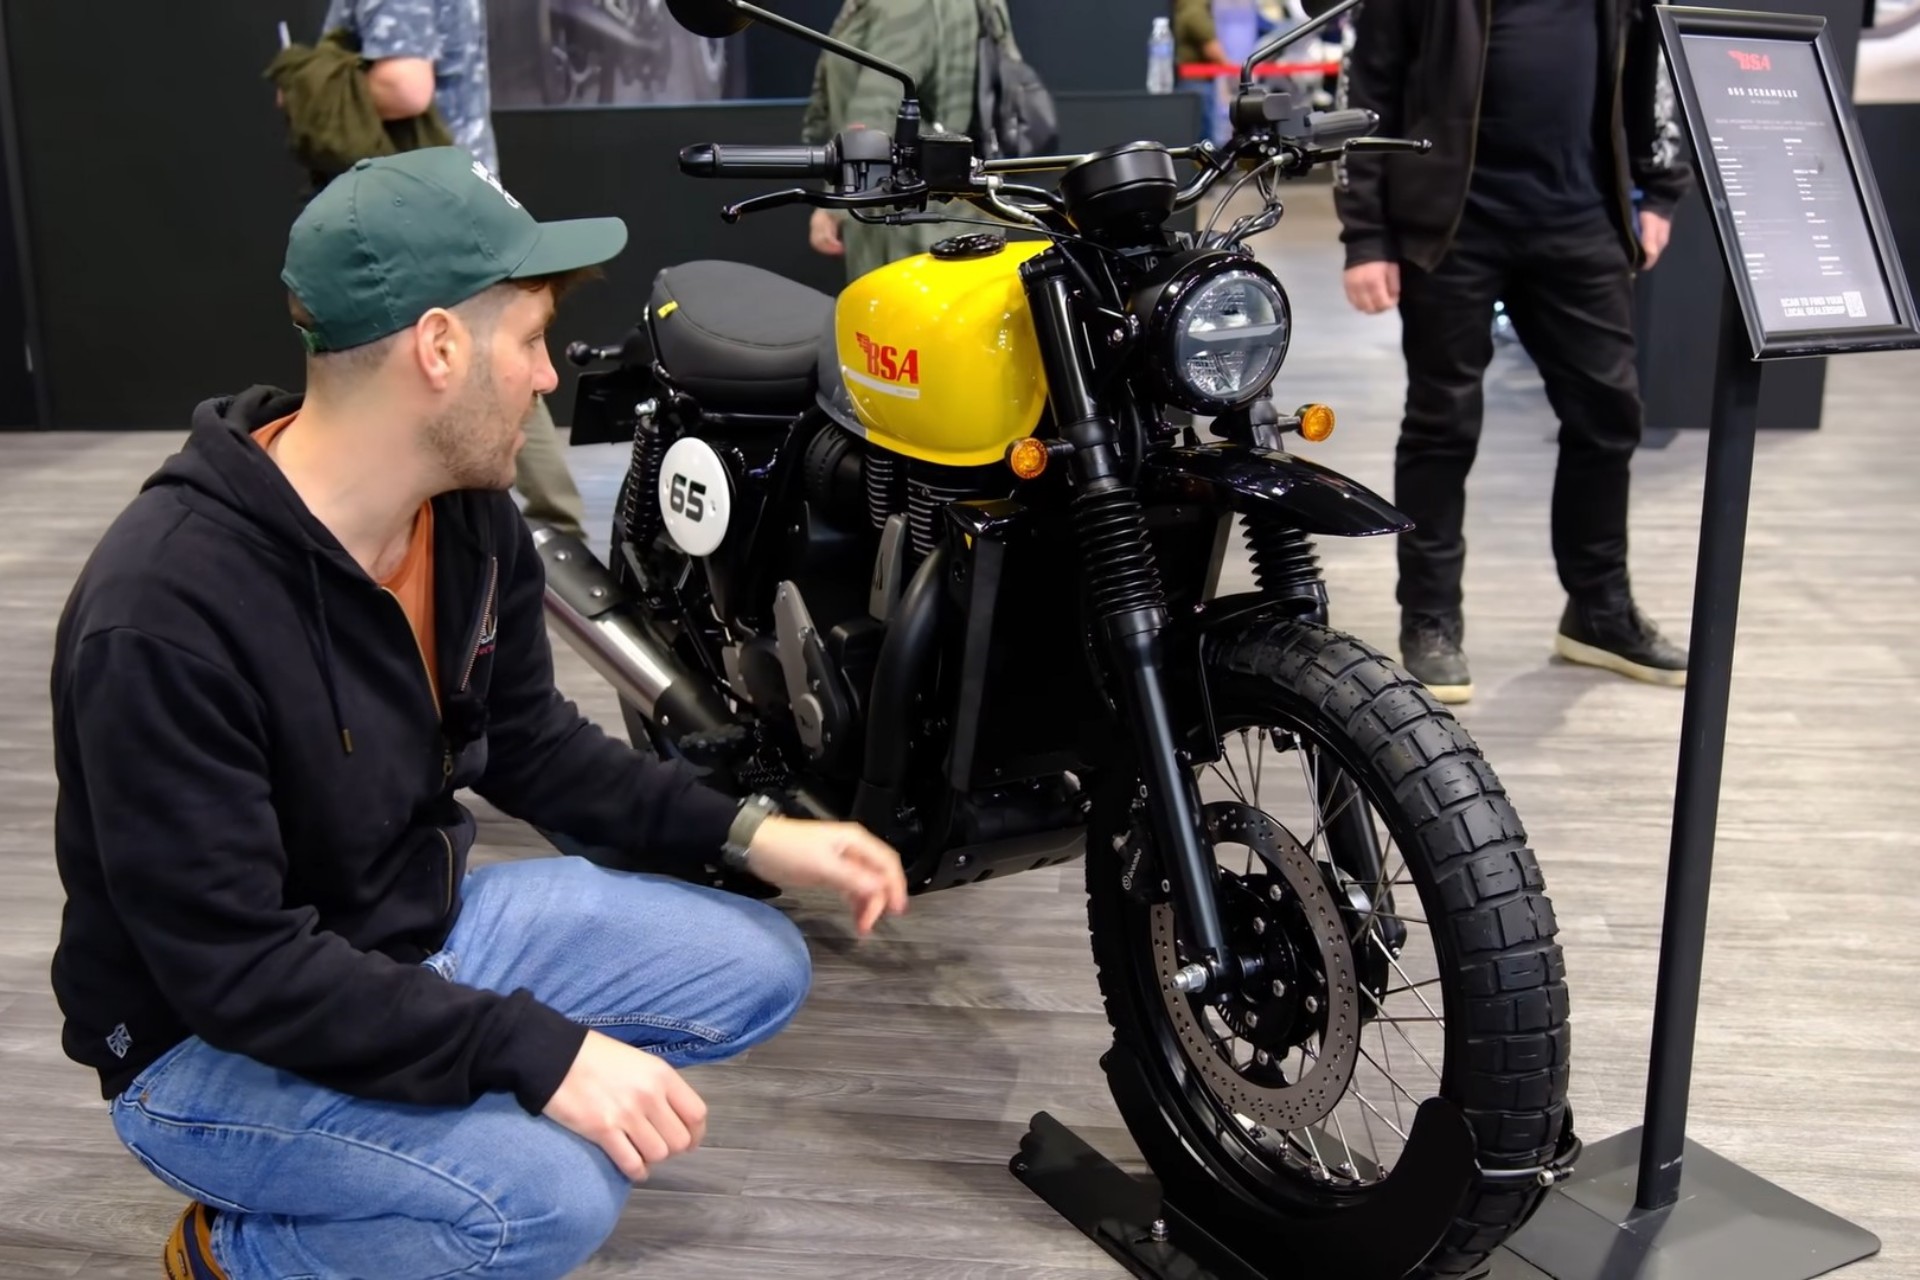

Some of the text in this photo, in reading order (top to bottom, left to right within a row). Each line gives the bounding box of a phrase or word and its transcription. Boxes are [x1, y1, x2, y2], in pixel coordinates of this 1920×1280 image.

[1731, 51, 1771, 71] BSA
[1780, 298, 1799, 307] SCAN
[1799, 298, 1810, 306] TO
[1784, 307, 1805, 317] LOCAL
[859, 334, 919, 384] BSA
[670, 472, 707, 523] 65
